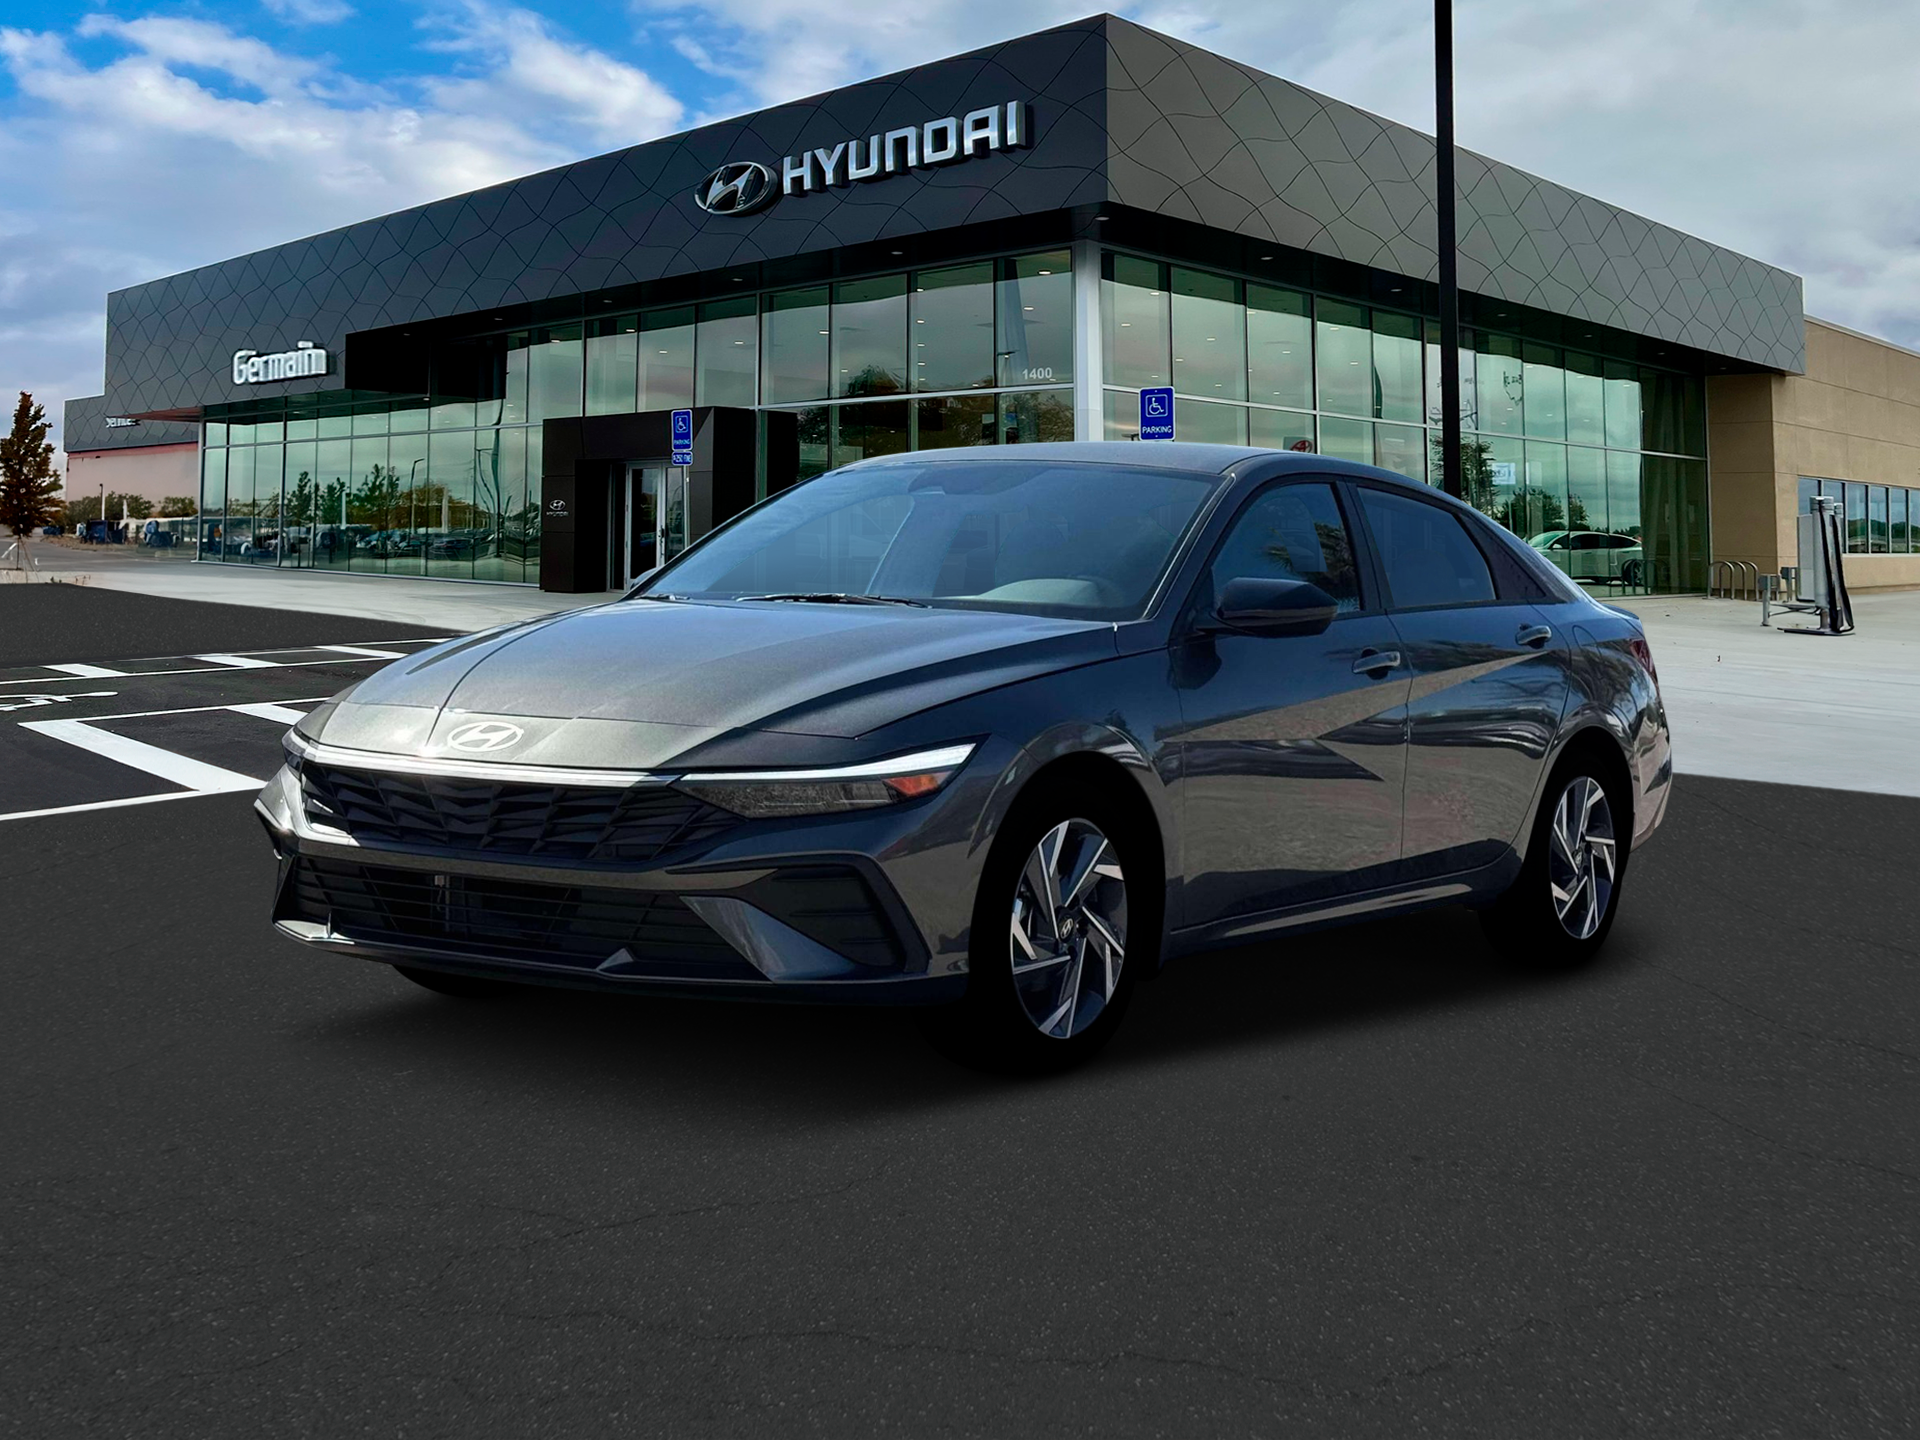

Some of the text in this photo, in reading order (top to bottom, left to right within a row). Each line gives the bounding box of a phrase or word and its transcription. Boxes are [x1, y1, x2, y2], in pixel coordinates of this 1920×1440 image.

[782, 100, 1026, 195] HYUNDAI
[233, 340, 327, 385] Germain
[1022, 367, 1053, 380] 1400
[1141, 425, 1172, 434] PARKING
